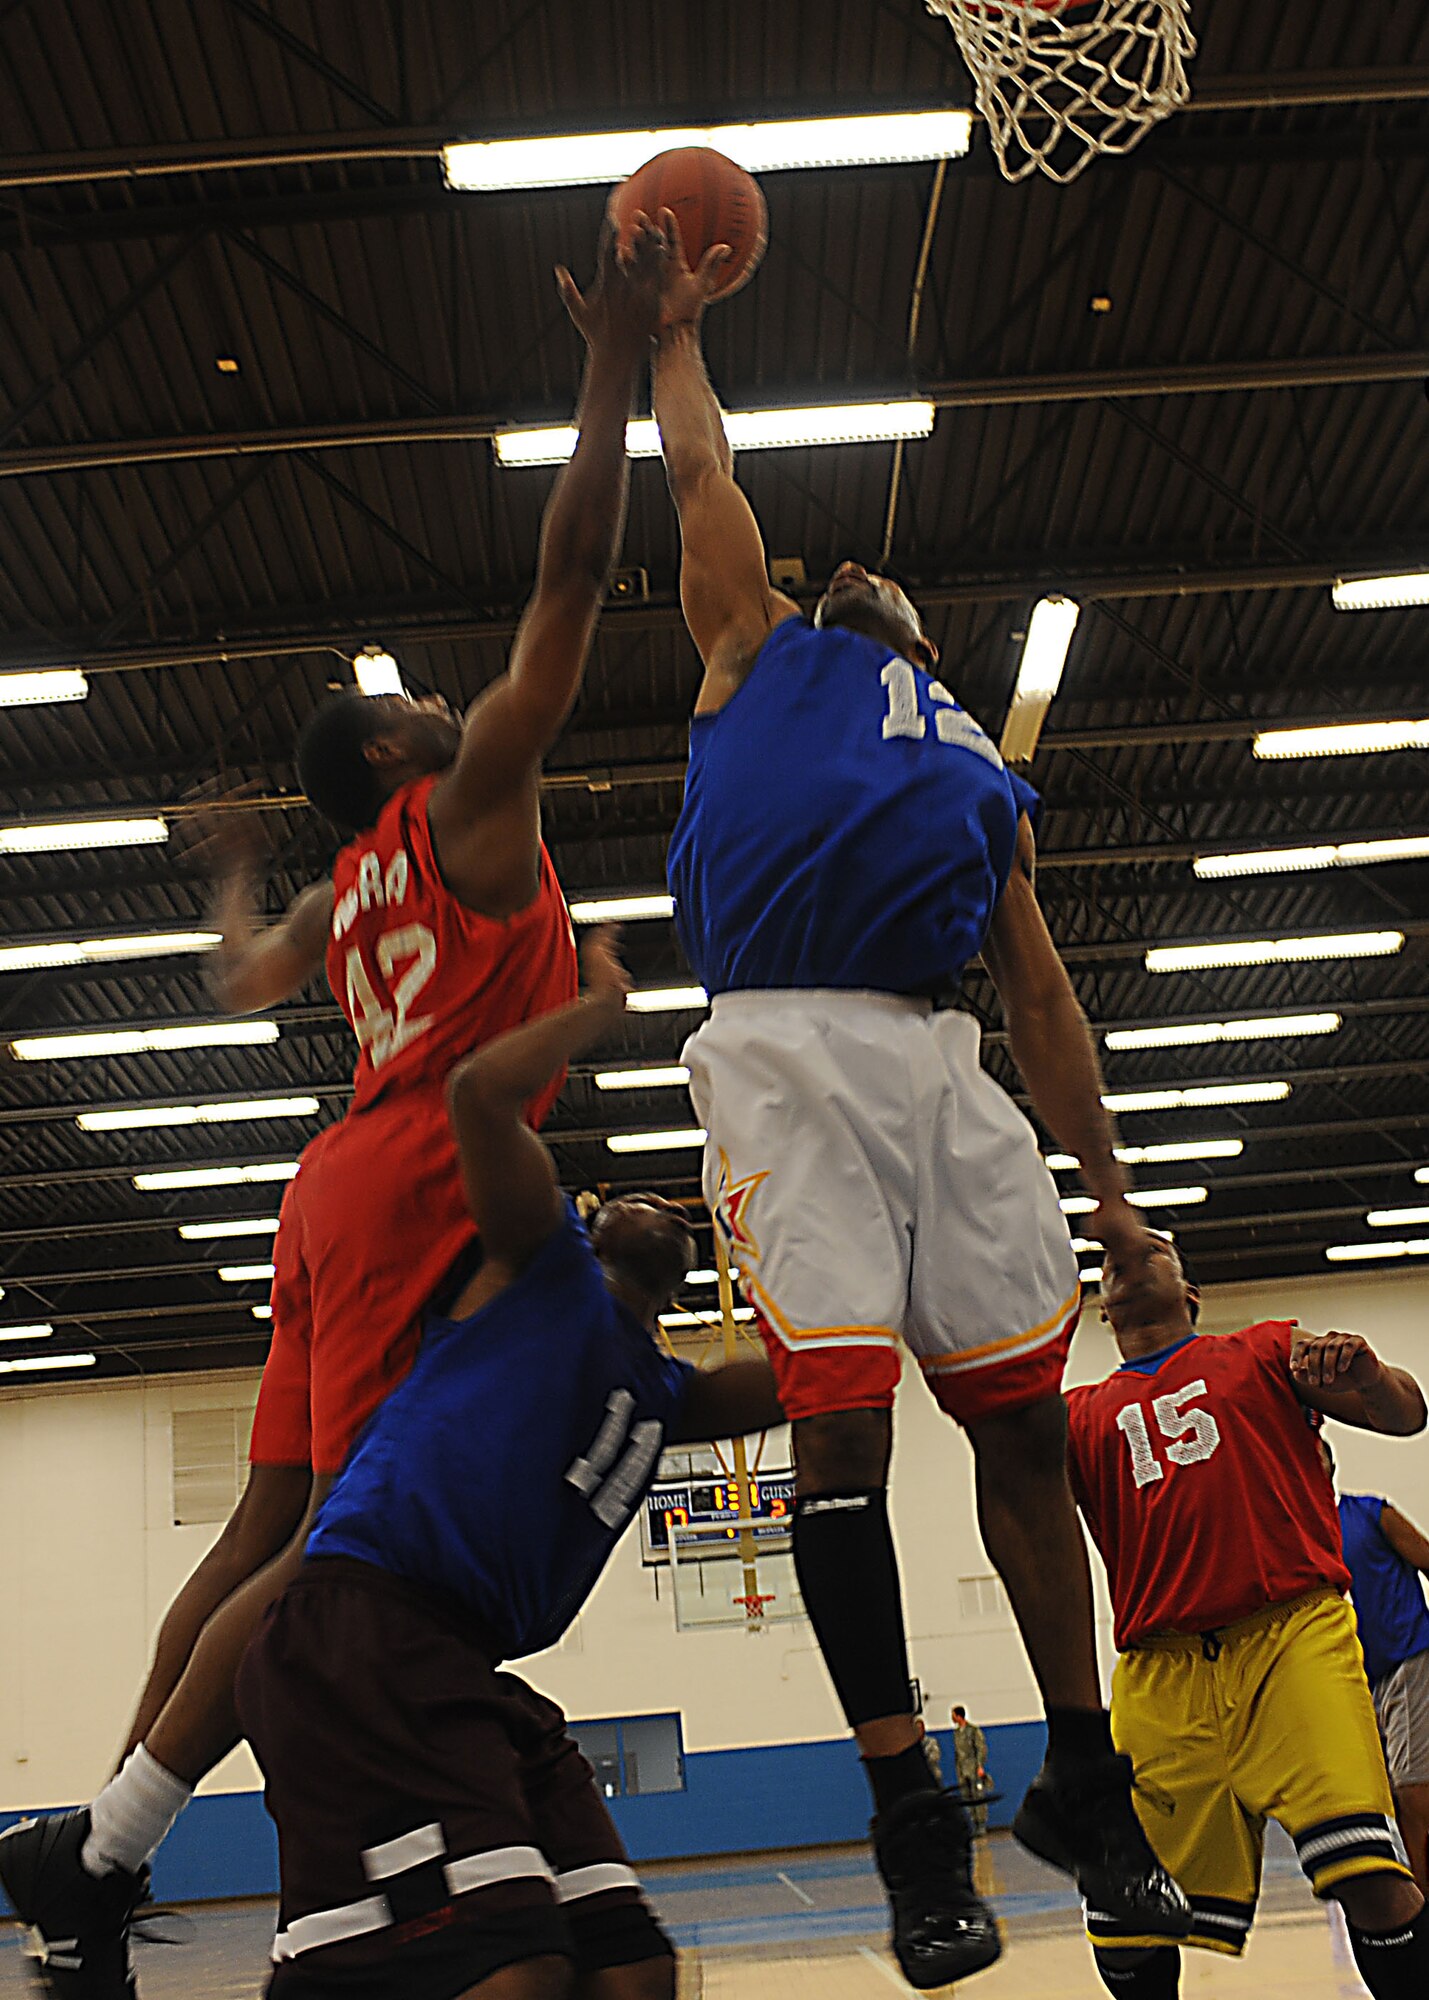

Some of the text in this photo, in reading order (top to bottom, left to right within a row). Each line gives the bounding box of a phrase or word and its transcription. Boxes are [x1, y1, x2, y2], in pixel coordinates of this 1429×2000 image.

[880, 657, 1004, 772] 12
[346, 922, 437, 1071] 42
[563, 1388, 664, 1530] 11
[1116, 1379, 1221, 1489] 15
[648, 1494, 687, 1511] HOME
[664, 1507, 688, 1529] 17
[762, 1483, 796, 1501] GUEST
